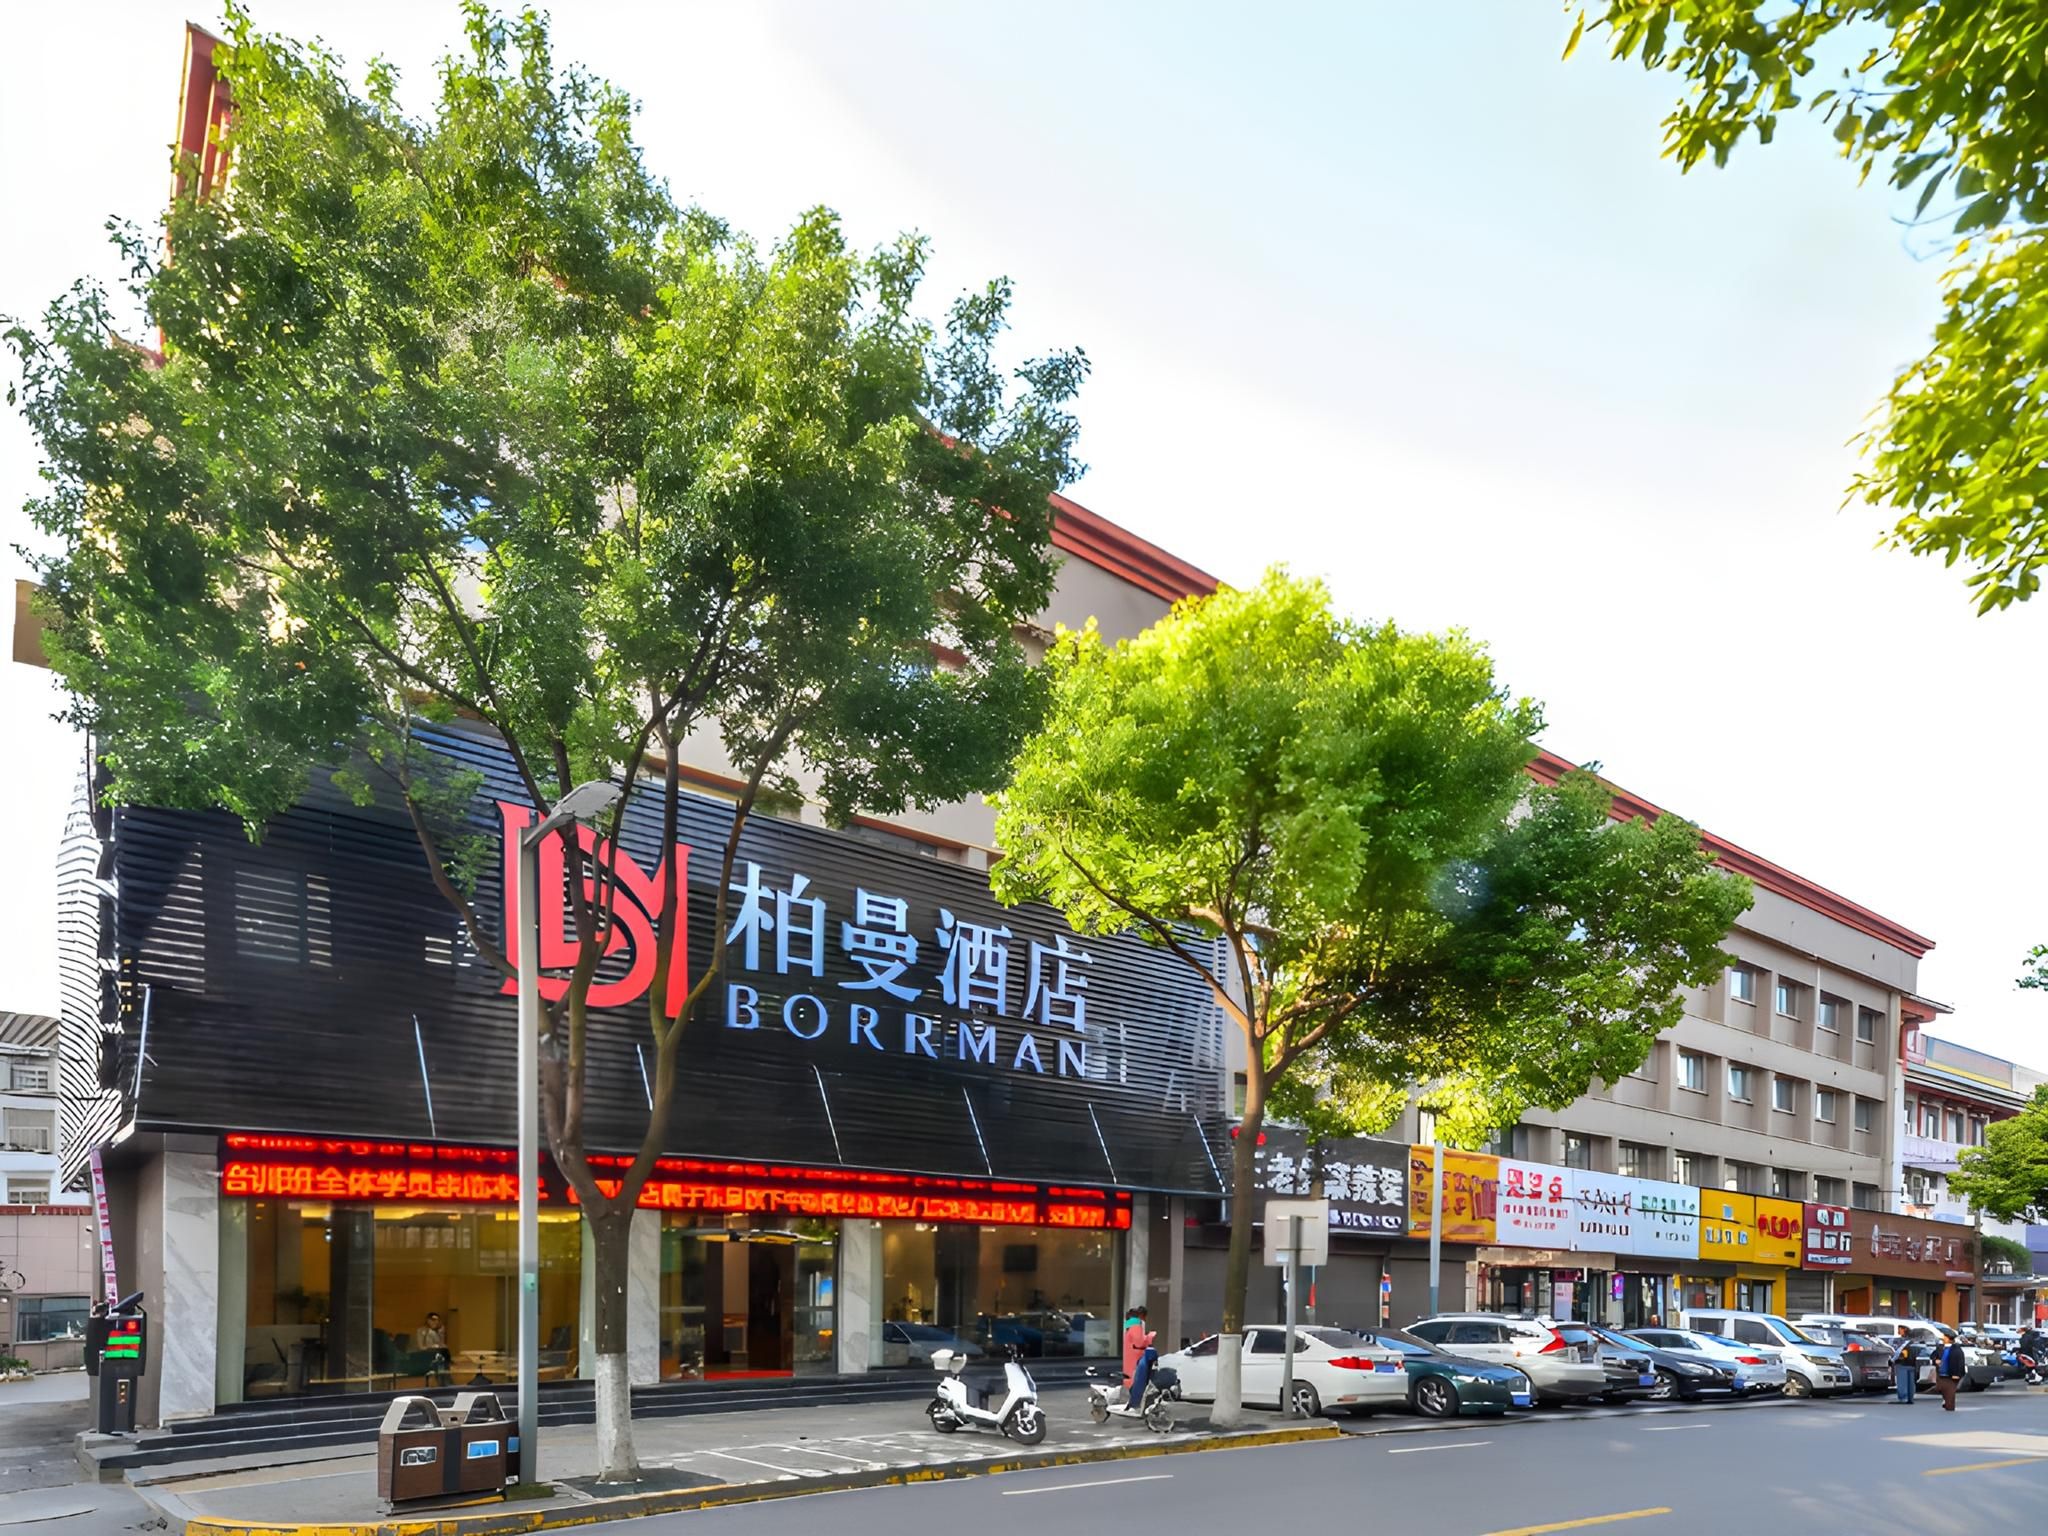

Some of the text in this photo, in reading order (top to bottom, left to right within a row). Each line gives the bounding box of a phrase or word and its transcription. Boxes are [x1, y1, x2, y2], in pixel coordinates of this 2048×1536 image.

[726, 861, 1093, 1033] 柏曼酒店
[726, 984, 1086, 1077] BORRMAN
